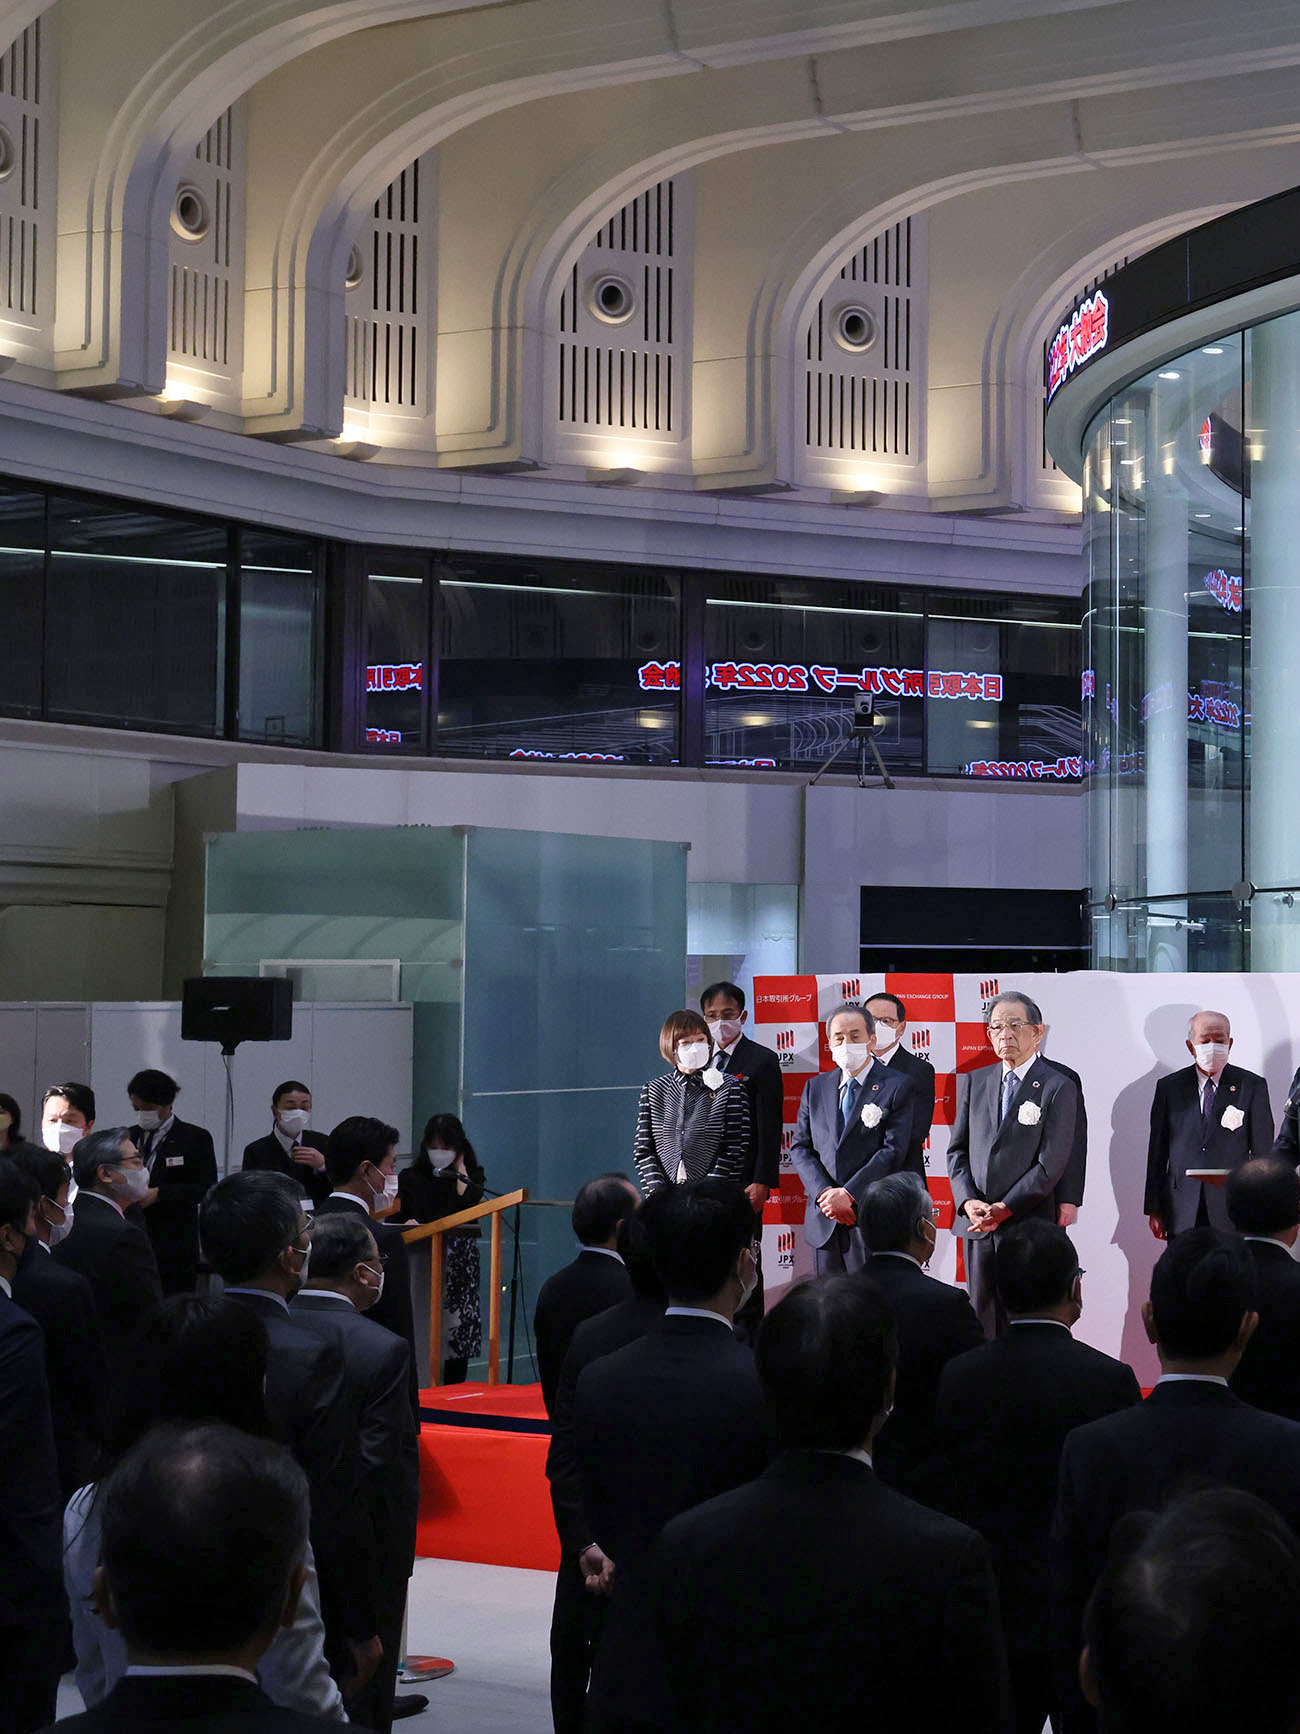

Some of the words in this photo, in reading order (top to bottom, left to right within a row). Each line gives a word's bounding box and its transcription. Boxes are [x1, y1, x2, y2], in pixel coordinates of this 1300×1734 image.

[756, 994, 813, 1003] 日本取引所グループ
[778, 1255, 794, 1263] JPX
